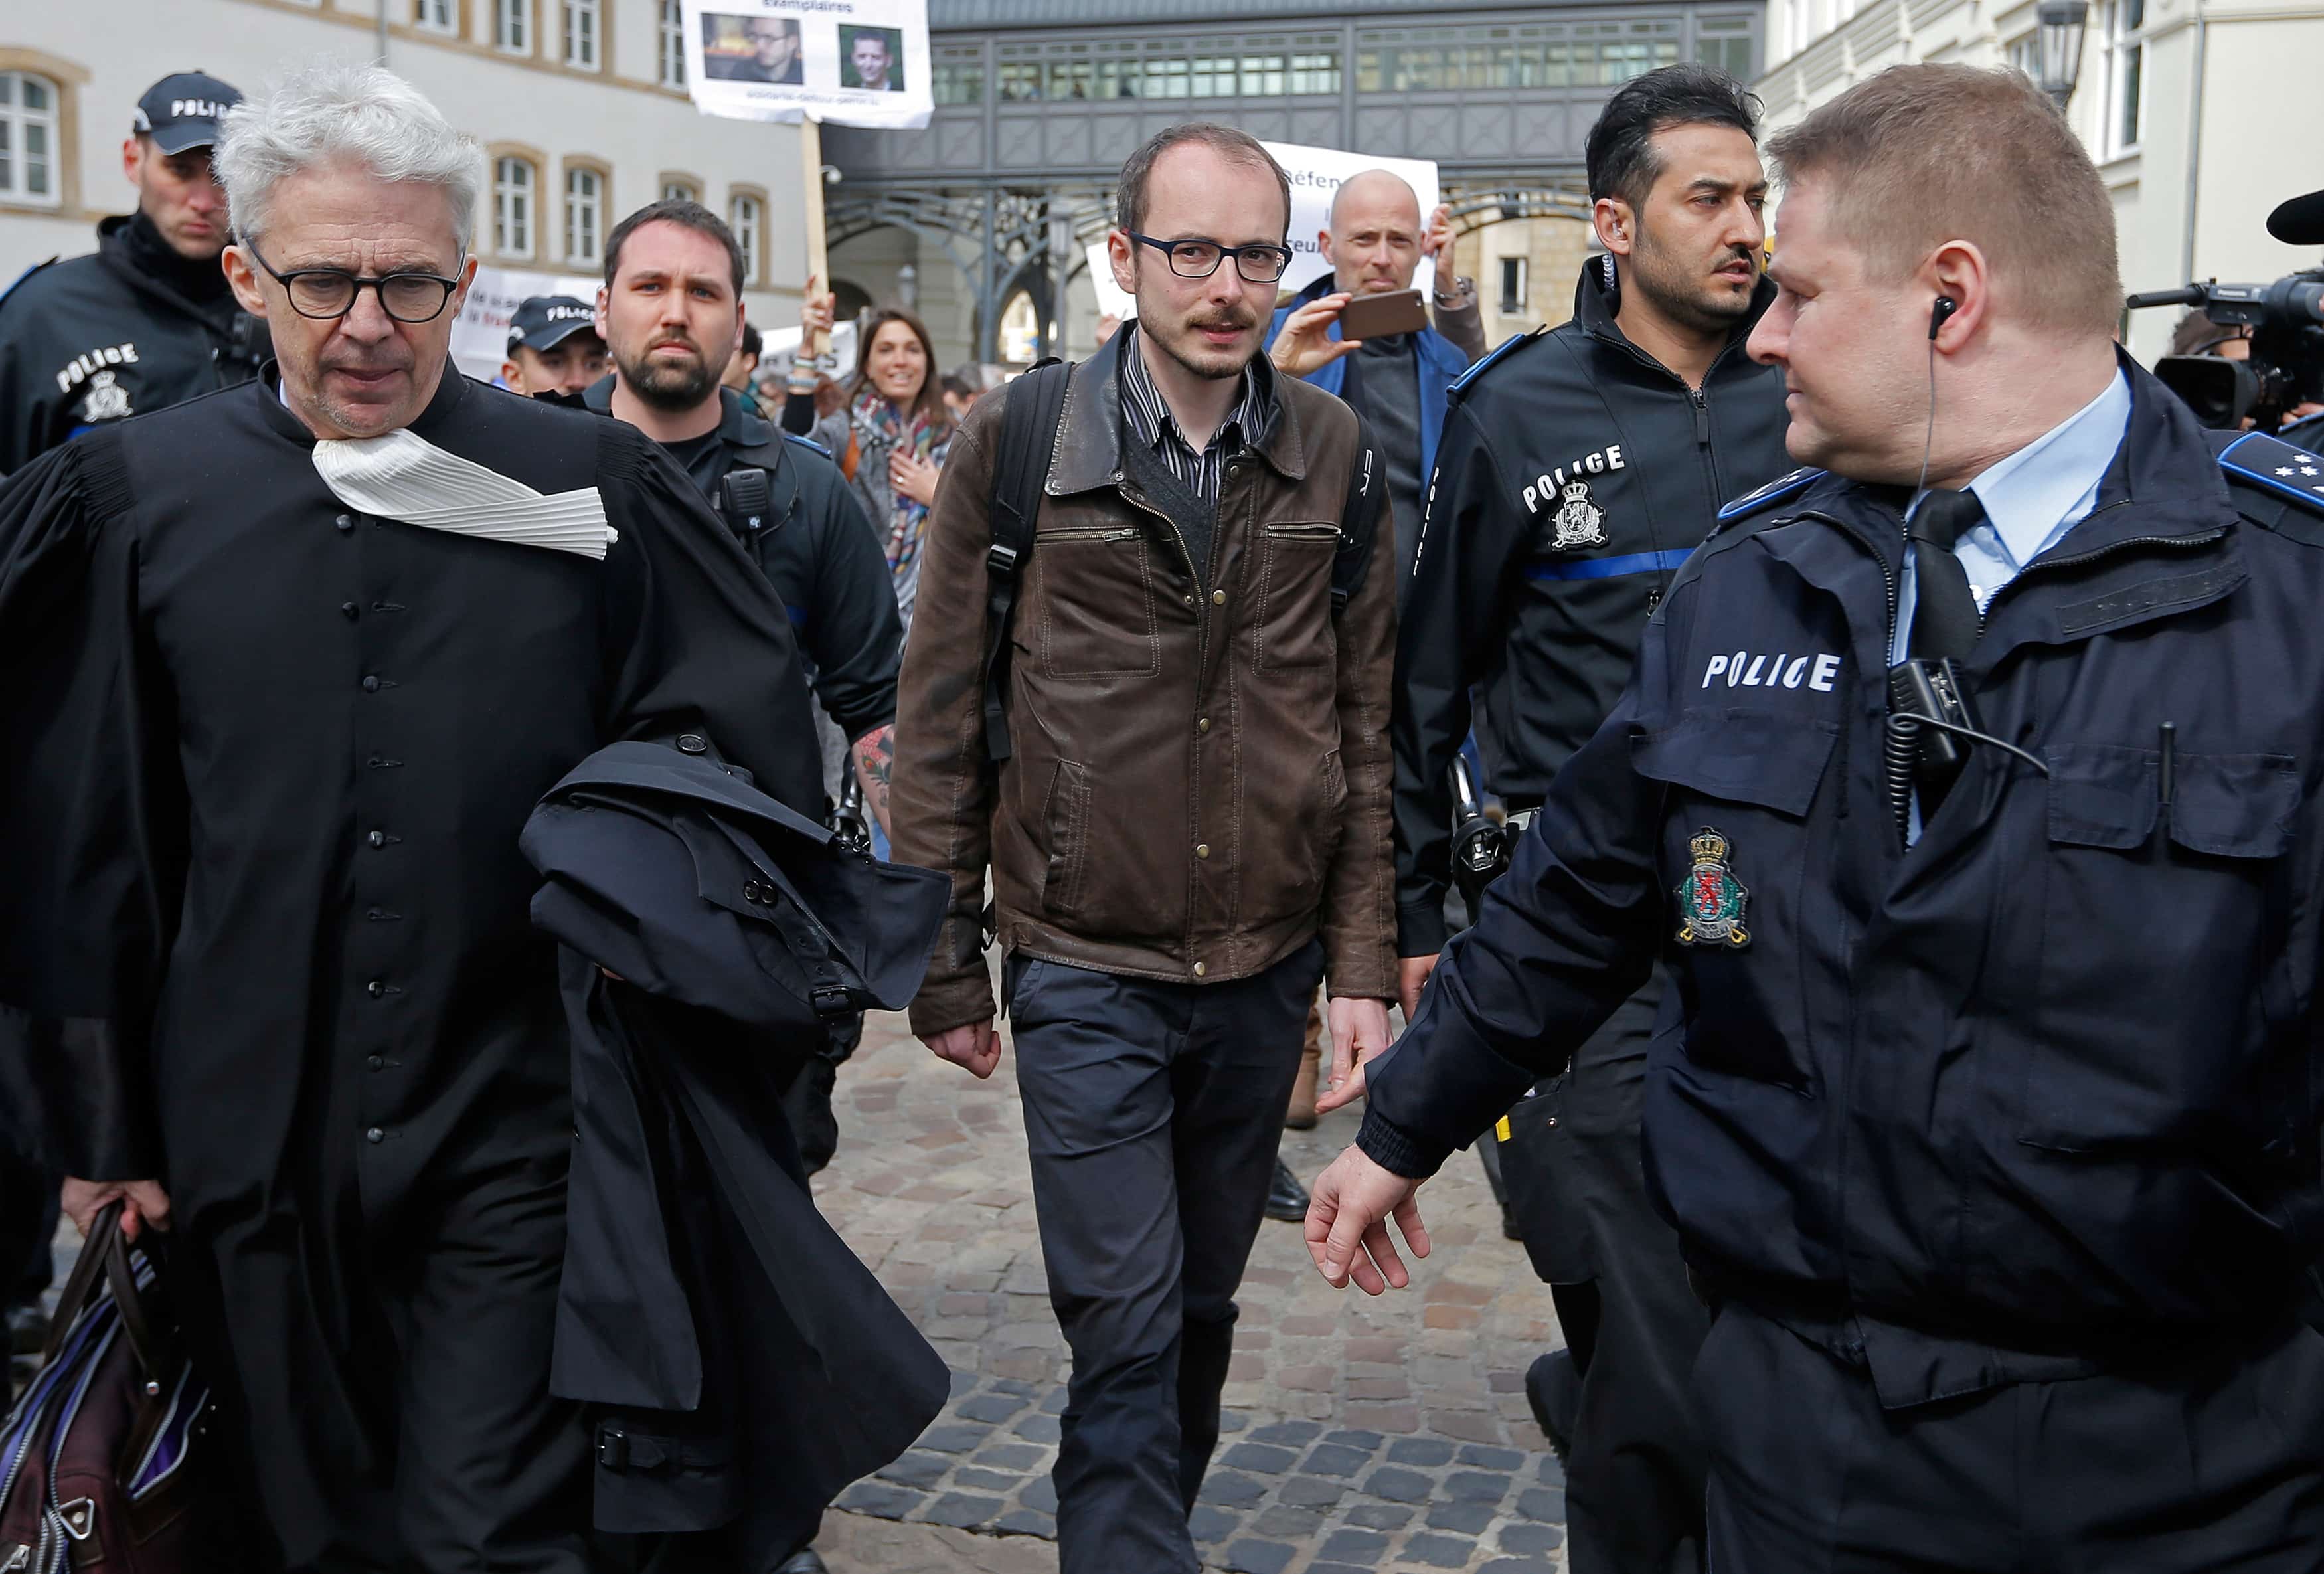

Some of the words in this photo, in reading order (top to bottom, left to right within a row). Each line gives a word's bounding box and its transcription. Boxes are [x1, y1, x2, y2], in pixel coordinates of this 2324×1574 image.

[56, 343, 139, 393] POLICE
[1523, 444, 1625, 513] POLICE
[1701, 651, 1841, 692] POLICE
